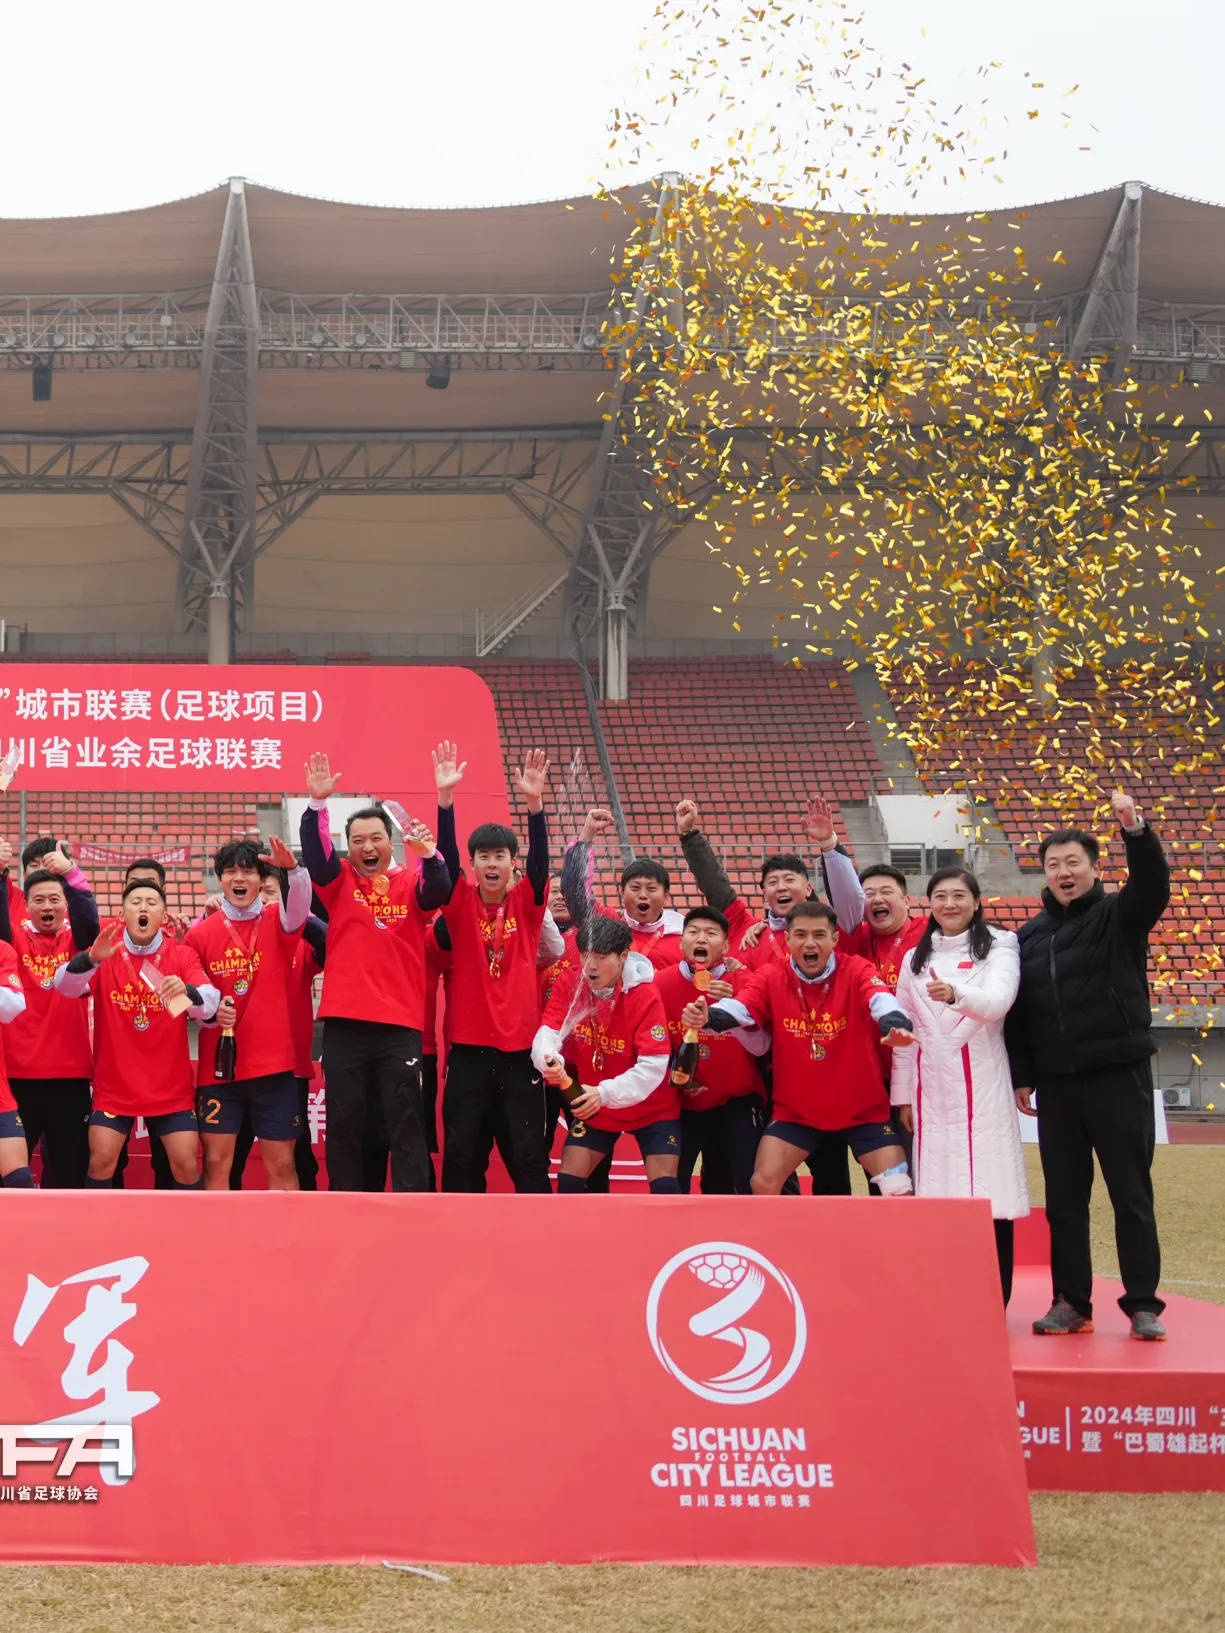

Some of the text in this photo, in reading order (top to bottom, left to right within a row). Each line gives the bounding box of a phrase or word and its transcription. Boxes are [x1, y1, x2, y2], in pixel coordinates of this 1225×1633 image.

[672, 1427, 807, 1451] SICHUAN
[694, 1453, 786, 1462] FOOTBALL
[650, 1463, 835, 1488] CITY LEAGUE
[679, 1494, 811, 1507] 四川足球城市联赛
